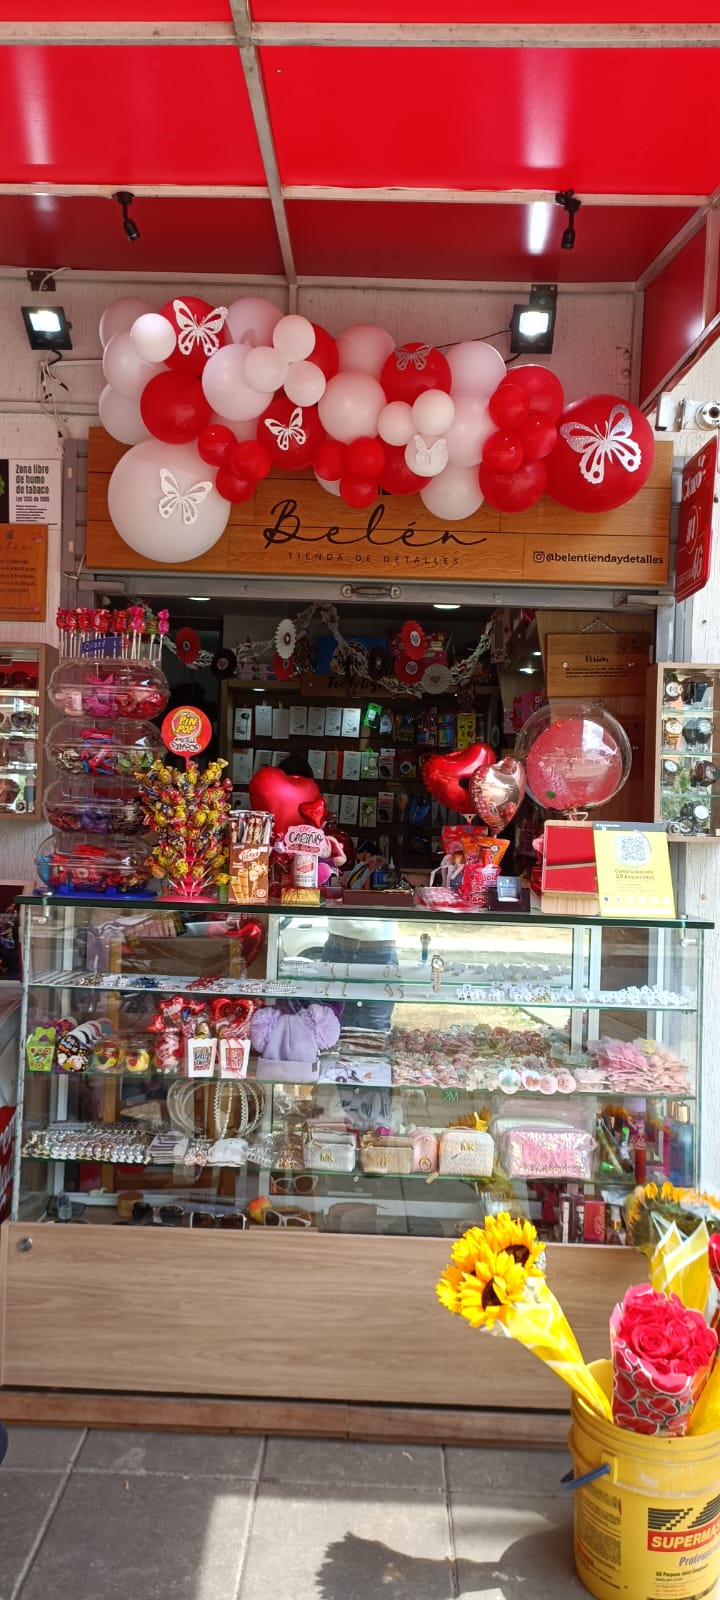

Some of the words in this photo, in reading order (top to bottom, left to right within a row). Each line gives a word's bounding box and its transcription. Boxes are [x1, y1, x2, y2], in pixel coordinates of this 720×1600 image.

[16, 464, 32, 474] Zona
[33, 463, 49, 474] libre
[16, 475, 24, 484] de
[26, 475, 45, 484] humo
[16, 485, 24, 494] de
[26, 485, 49, 494] tabaco
[263, 499, 488, 549] Belén
[288, 552, 344, 562] TIENDA
[355, 554, 372, 563] DE
[384, 555, 460, 566] DETALLES
[545, 552, 665, 565] @belentiendaydetalles
[175, 724, 197, 735] POP
[288, 831, 323, 845] CARIÑO
[521, 1142, 576, 1166] LOVE
